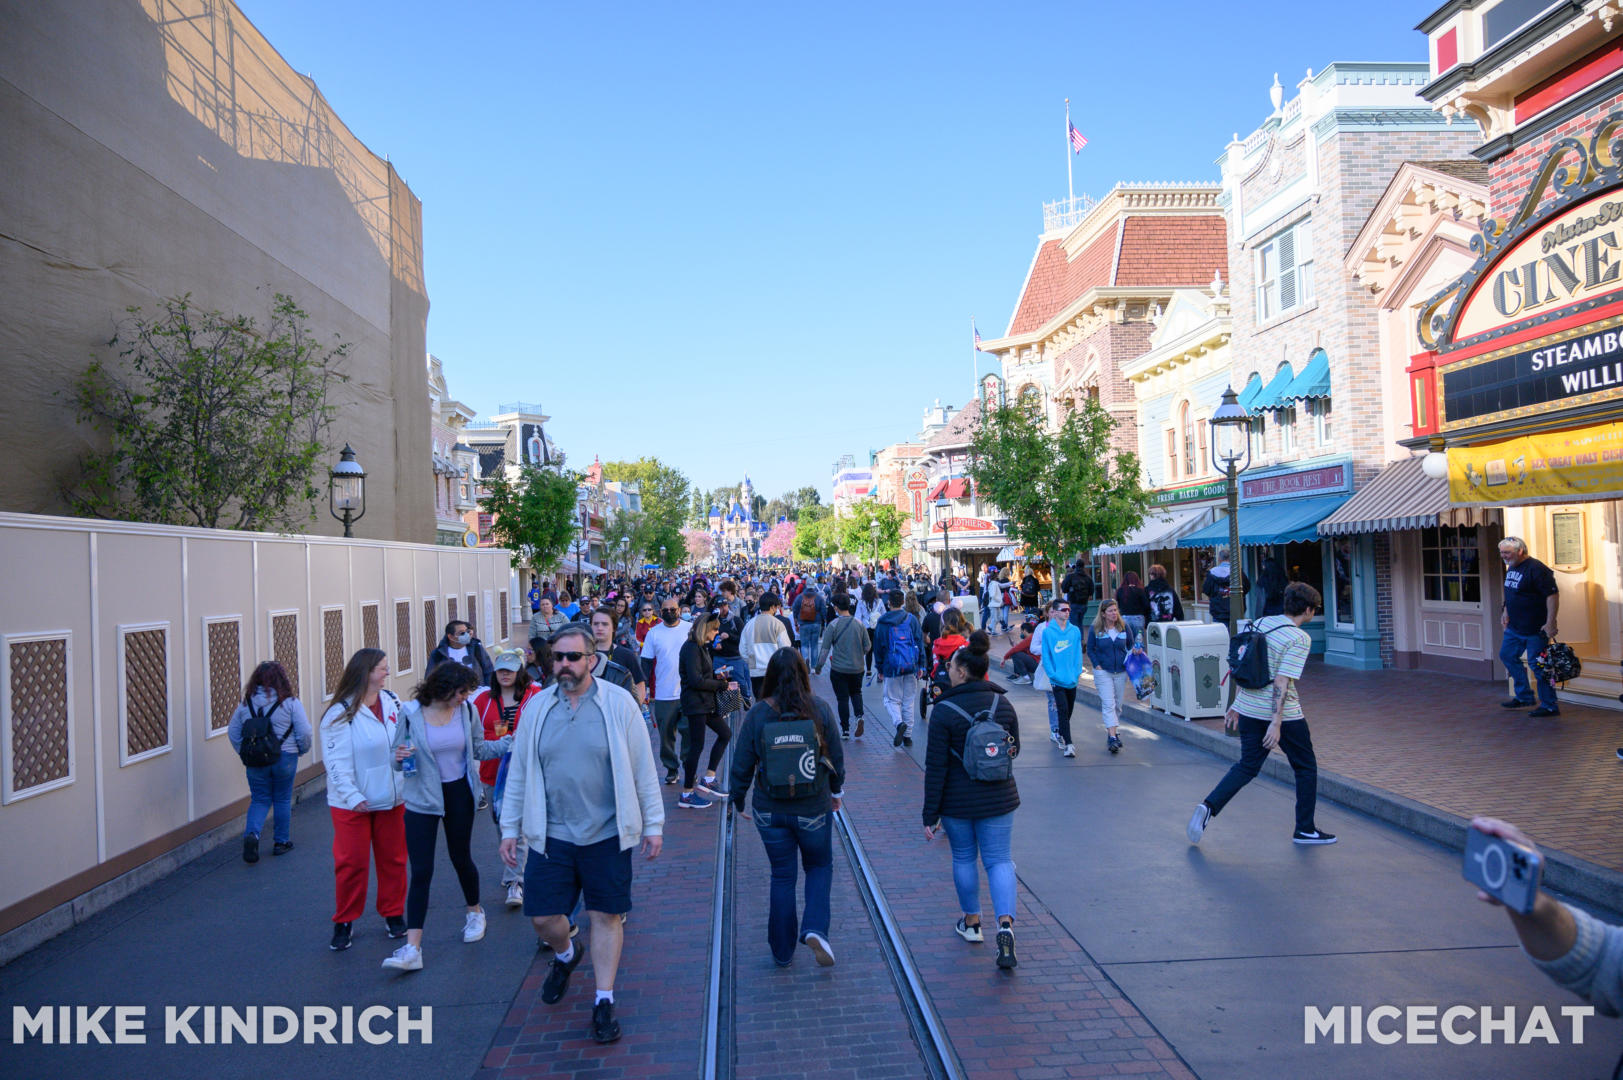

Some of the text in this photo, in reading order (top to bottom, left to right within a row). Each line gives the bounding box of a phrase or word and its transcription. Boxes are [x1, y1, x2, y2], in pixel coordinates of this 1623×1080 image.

[1541, 201, 1623, 254] Main St
[1493, 231, 1623, 318] CINE
[1532, 330, 1623, 371] STEAMB
[1561, 362, 1623, 394] WILLI
[1575, 451, 1598, 465] WALT
[1157, 484, 1226, 503] FRESH BAKED GOODS
[1261, 473, 1321, 493] THE BOOK REST
